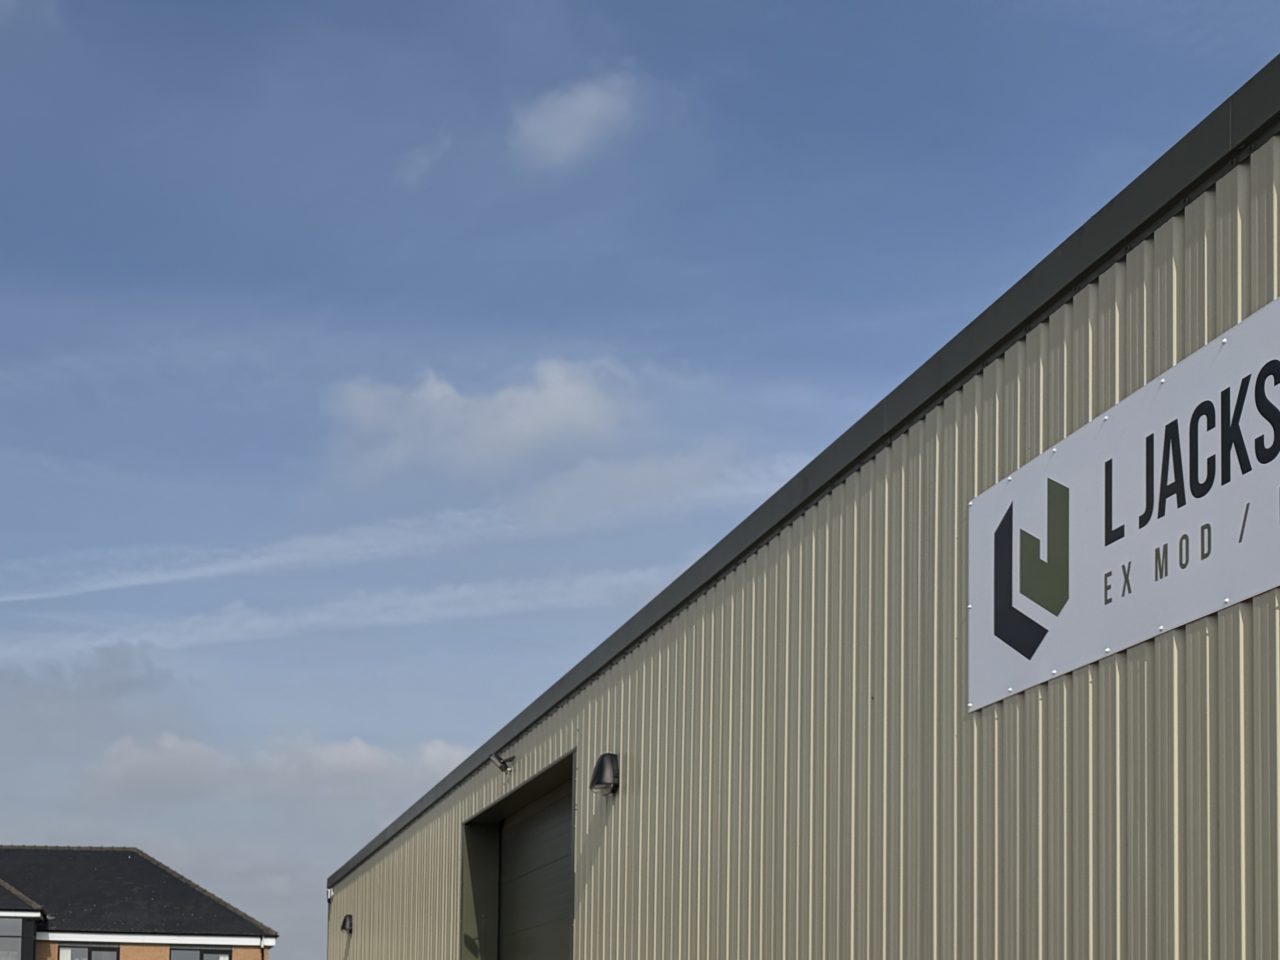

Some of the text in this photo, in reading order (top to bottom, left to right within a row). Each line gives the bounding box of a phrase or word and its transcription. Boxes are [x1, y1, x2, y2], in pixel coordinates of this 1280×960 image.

[1104, 458, 1125, 546] L
[1104, 561, 1132, 605] EX
[1154, 523, 1212, 581] MOD
